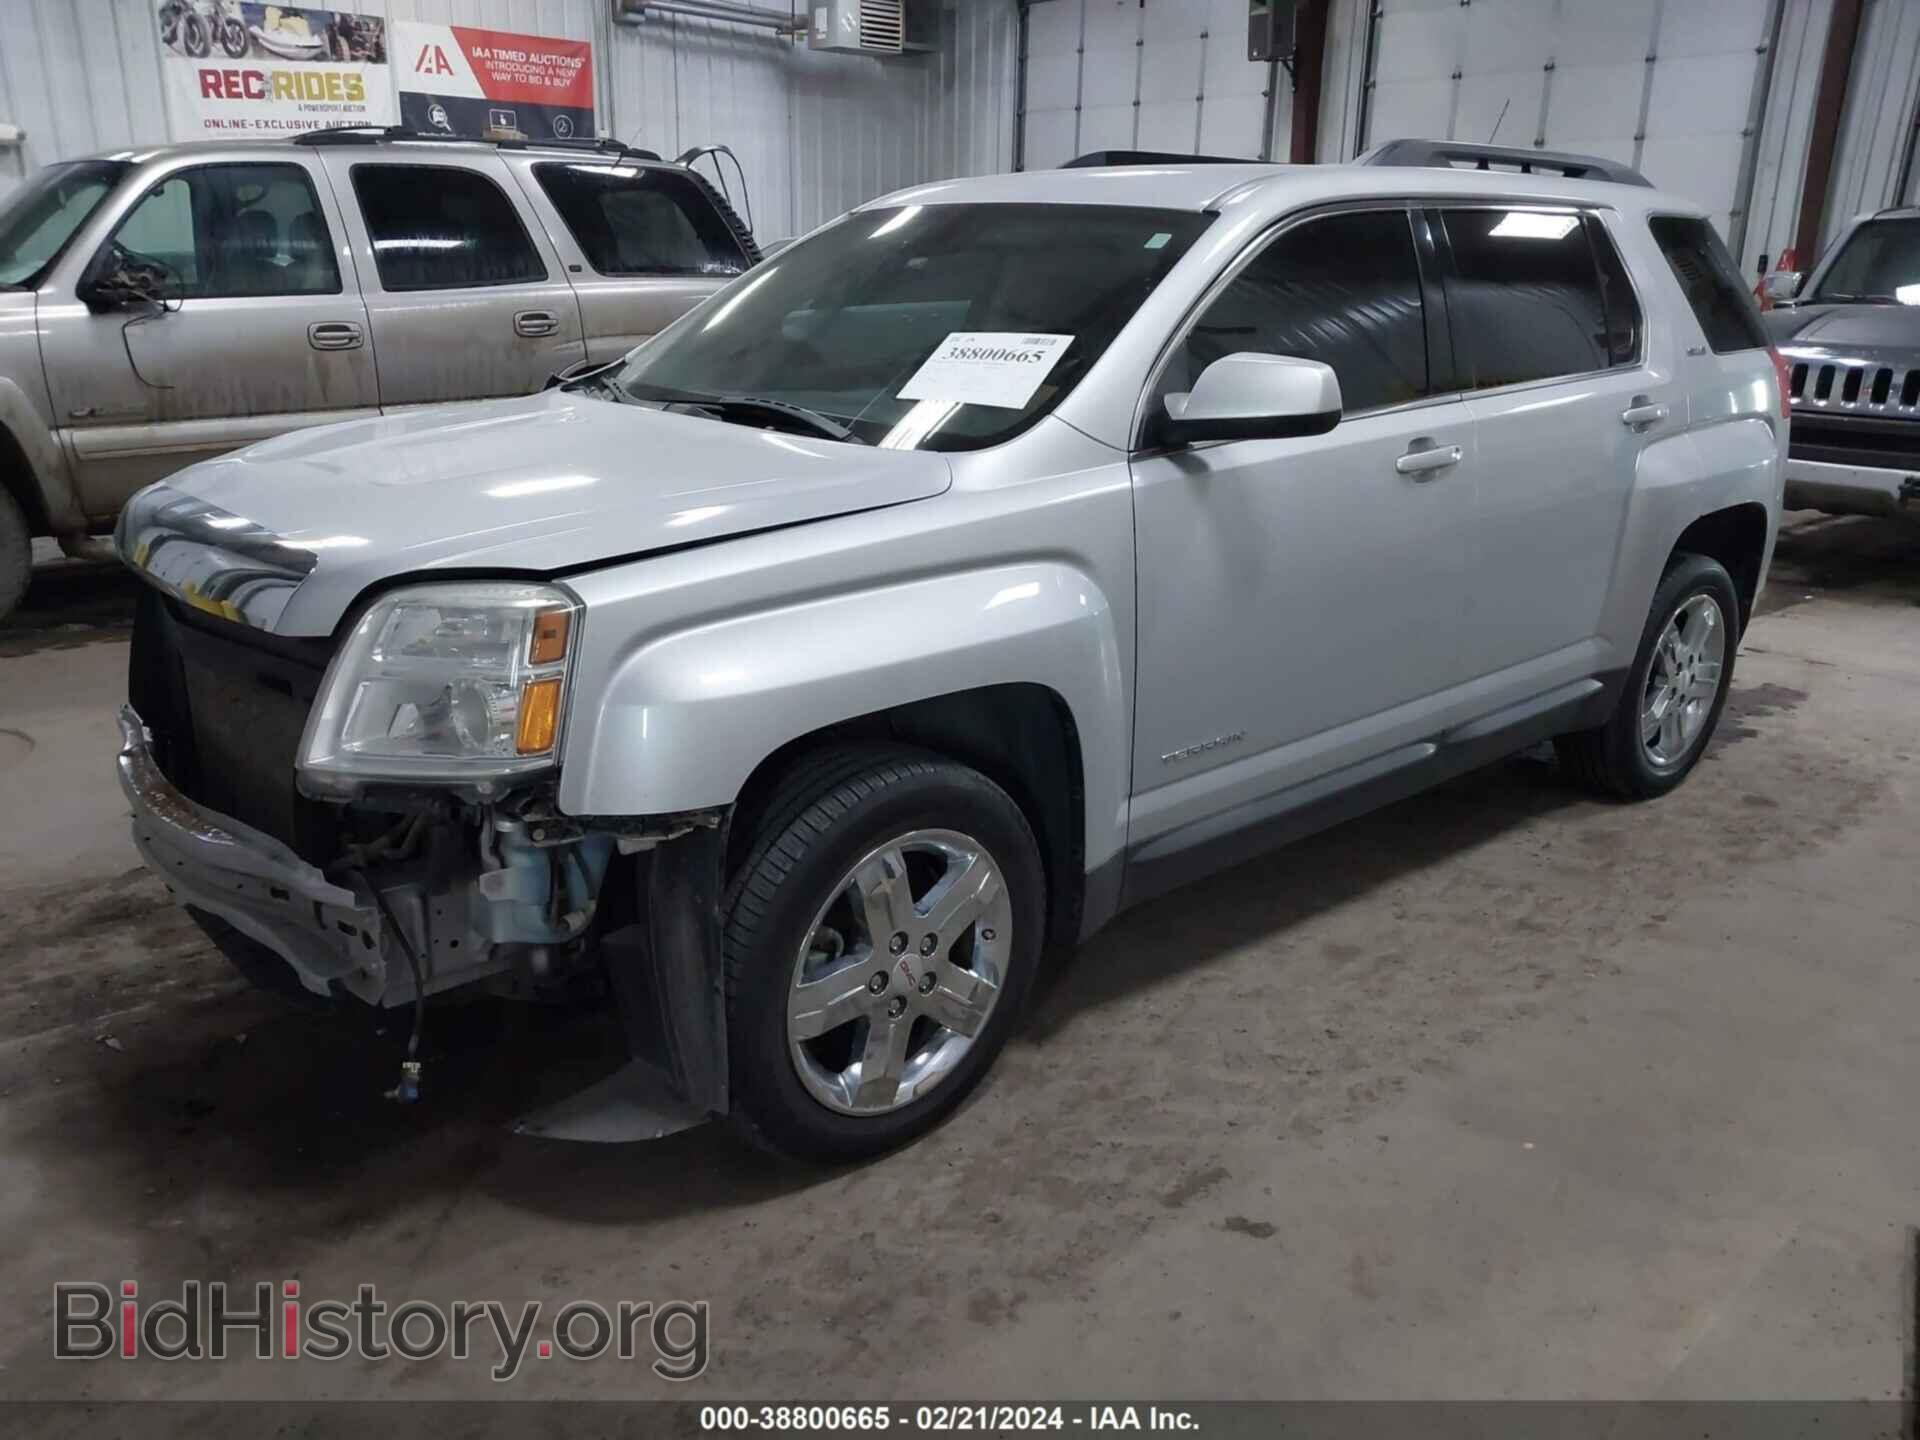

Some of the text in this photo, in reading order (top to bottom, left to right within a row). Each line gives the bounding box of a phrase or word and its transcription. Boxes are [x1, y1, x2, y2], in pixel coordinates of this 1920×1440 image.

[471, 46, 491, 59] IAA
[492, 48, 526, 62] TIMED
[485, 61, 577, 78] INTRODUCING A NEW
[198, 69, 265, 99] REC
[272, 71, 364, 101] RIDES
[491, 72, 572, 88] WAY TO BID & BUY
[204, 119, 372, 129] ONLINE-EXCLUSIVE AUCTION
[943, 347, 1046, 363] 38800665
